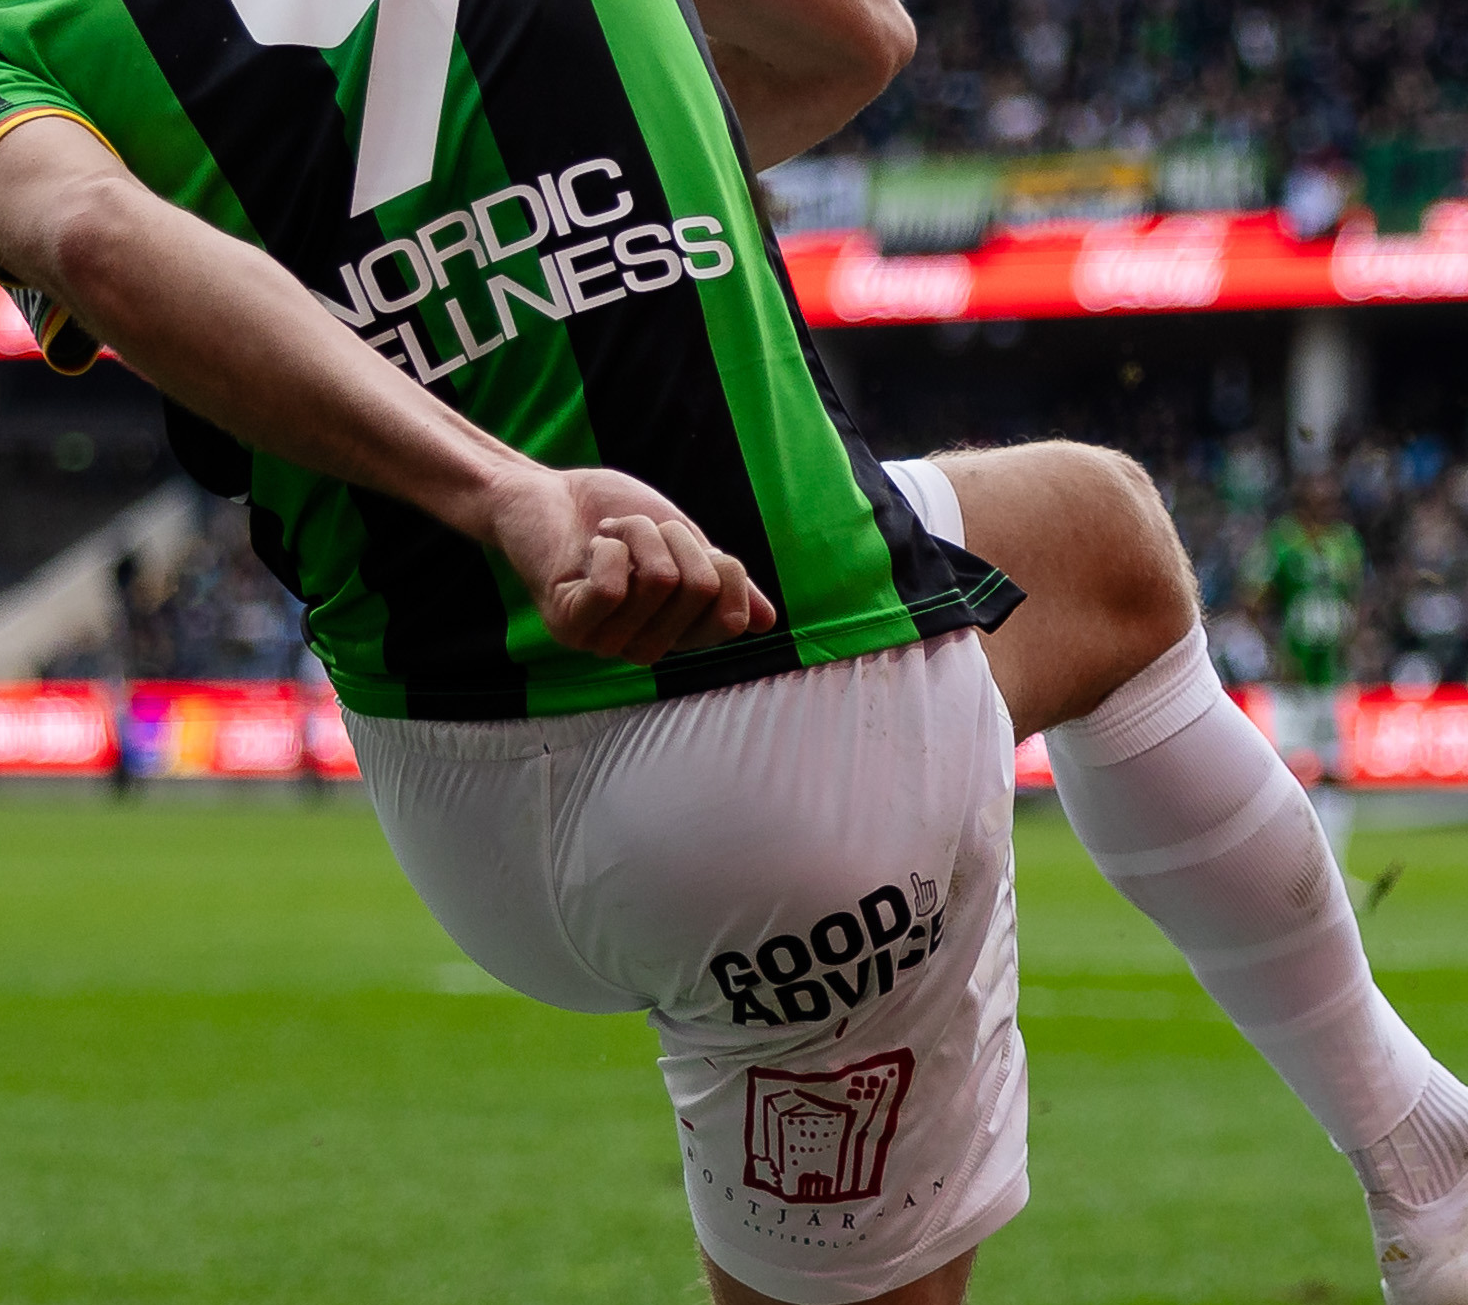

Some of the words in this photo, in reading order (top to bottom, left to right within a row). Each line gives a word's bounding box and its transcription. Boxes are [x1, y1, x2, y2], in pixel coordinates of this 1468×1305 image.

[310, 157, 633, 328] NORDIC
[364, 215, 734, 385] ELLNESS
[710, 885, 912, 1001] GOOD
